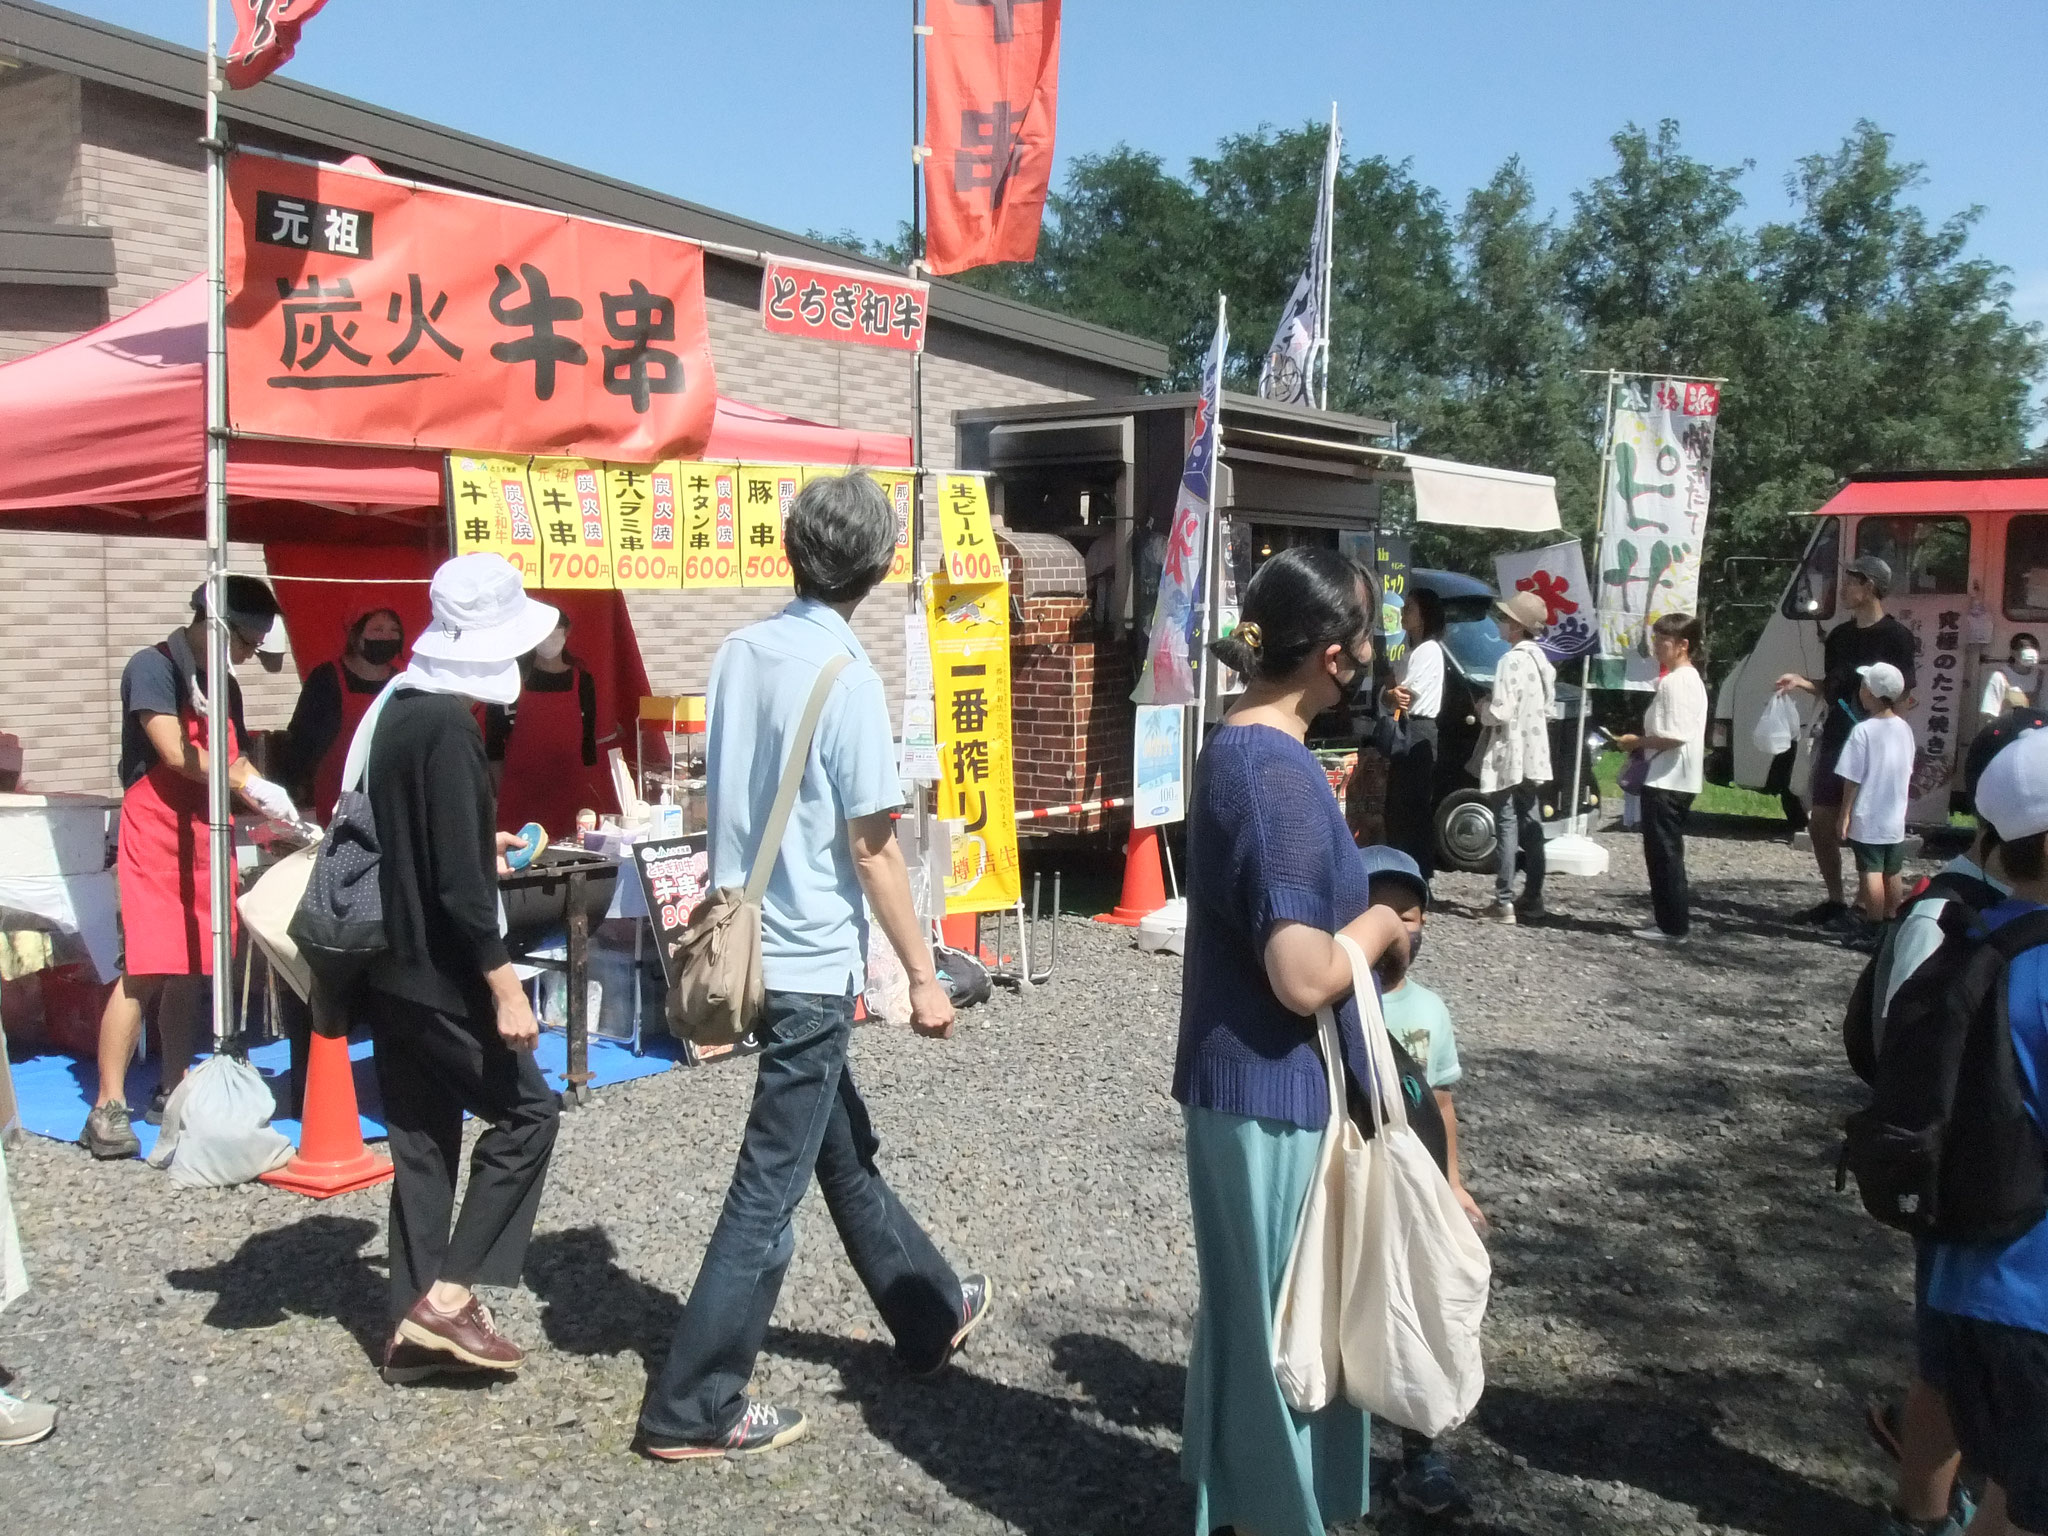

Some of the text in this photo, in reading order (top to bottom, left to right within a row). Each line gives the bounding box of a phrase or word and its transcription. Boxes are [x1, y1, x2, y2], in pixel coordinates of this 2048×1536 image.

[272, 200, 359, 255] 元祖
[769, 274, 922, 340] とちぎ和牛
[275, 262, 686, 413] 炭火牛串
[537, 467, 570, 483] 元祖
[460, 480, 491, 543] 牛串
[506, 485, 532, 539] 炭火焼
[543, 487, 577, 546] 牛串
[578, 475, 603, 539] 炭火焼
[614, 470, 645, 551] 牛ハラミ串
[653, 478, 673, 542] 炭火焼
[687, 475, 710, 550] 牛タン串
[716, 479, 733, 543] 炭火焼
[748, 480, 775, 548] 豚串
[950, 483, 983, 546] 生ビール
[549, 552, 610, 578] 700円
[617, 555, 678, 579] 600円
[685, 555, 738, 579] 600円
[952, 552, 1001, 579] 600円
[1515, 569, 1579, 627] 氷
[950, 664, 990, 834] 一番搾り
[647, 859, 695, 877] とちぎ和牛
[655, 875, 699, 902] 牛串
[952, 846, 1018, 883] 樽詰生
[662, 902, 701, 928] 80
